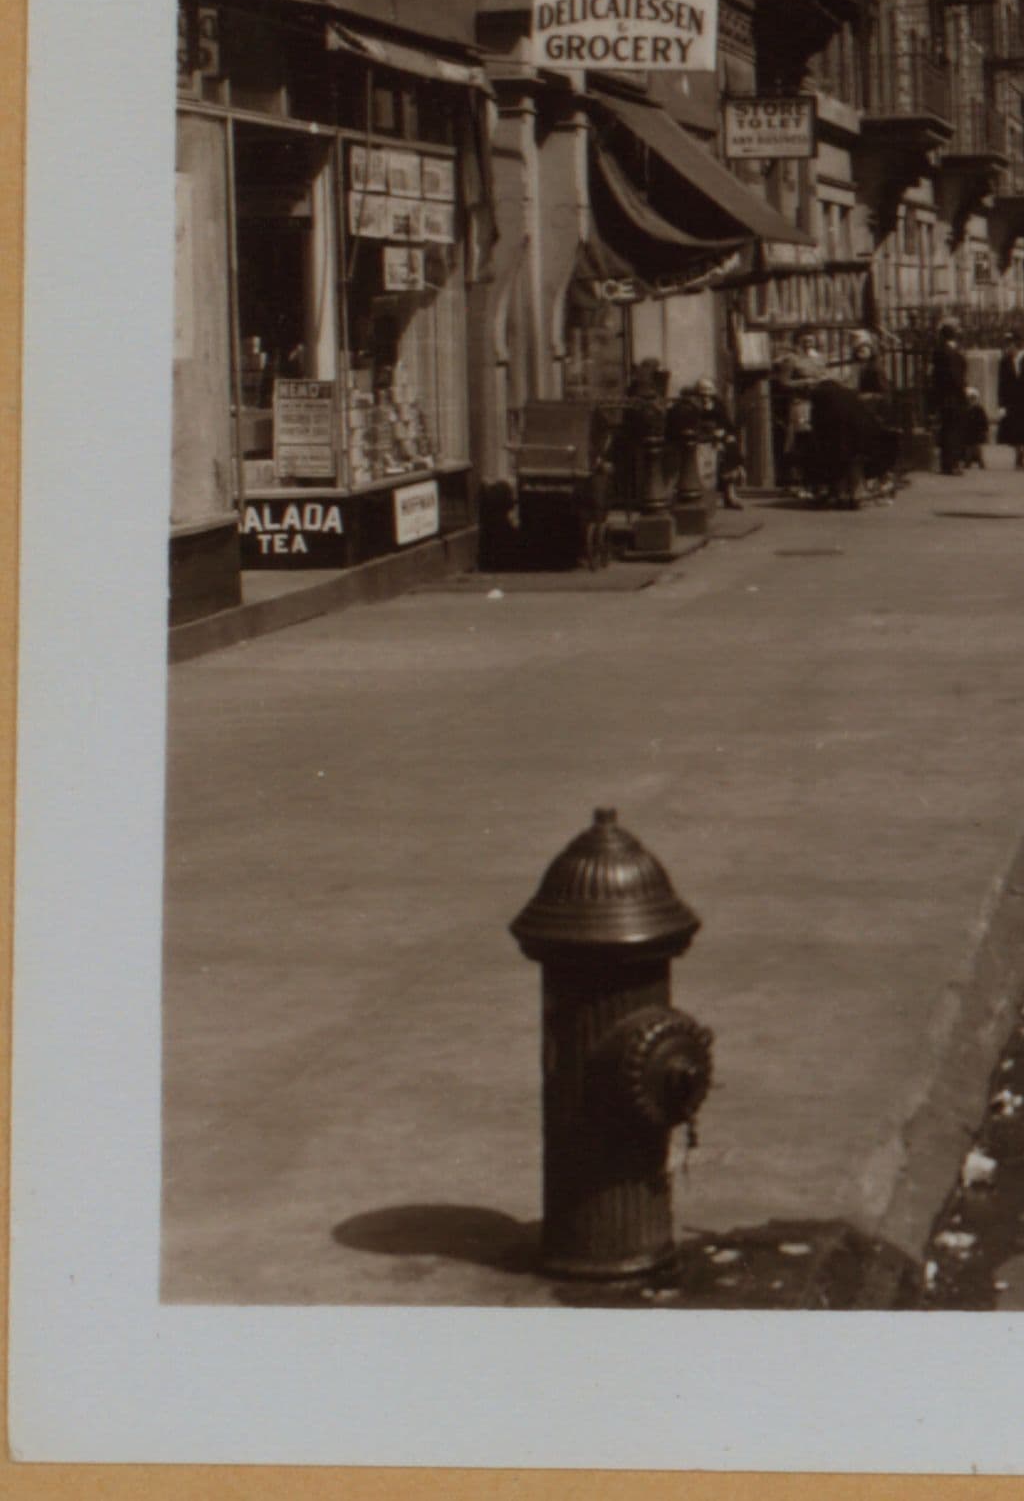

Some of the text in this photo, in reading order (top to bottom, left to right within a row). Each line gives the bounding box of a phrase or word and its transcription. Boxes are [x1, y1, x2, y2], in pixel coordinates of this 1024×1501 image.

[546, 35, 694, 63] GROCERY
[737, 118, 801, 129] TO LET
[749, 272, 867, 324] LAUNDRY
[238, 503, 342, 533] ALADA
[258, 534, 308, 554] TEA
